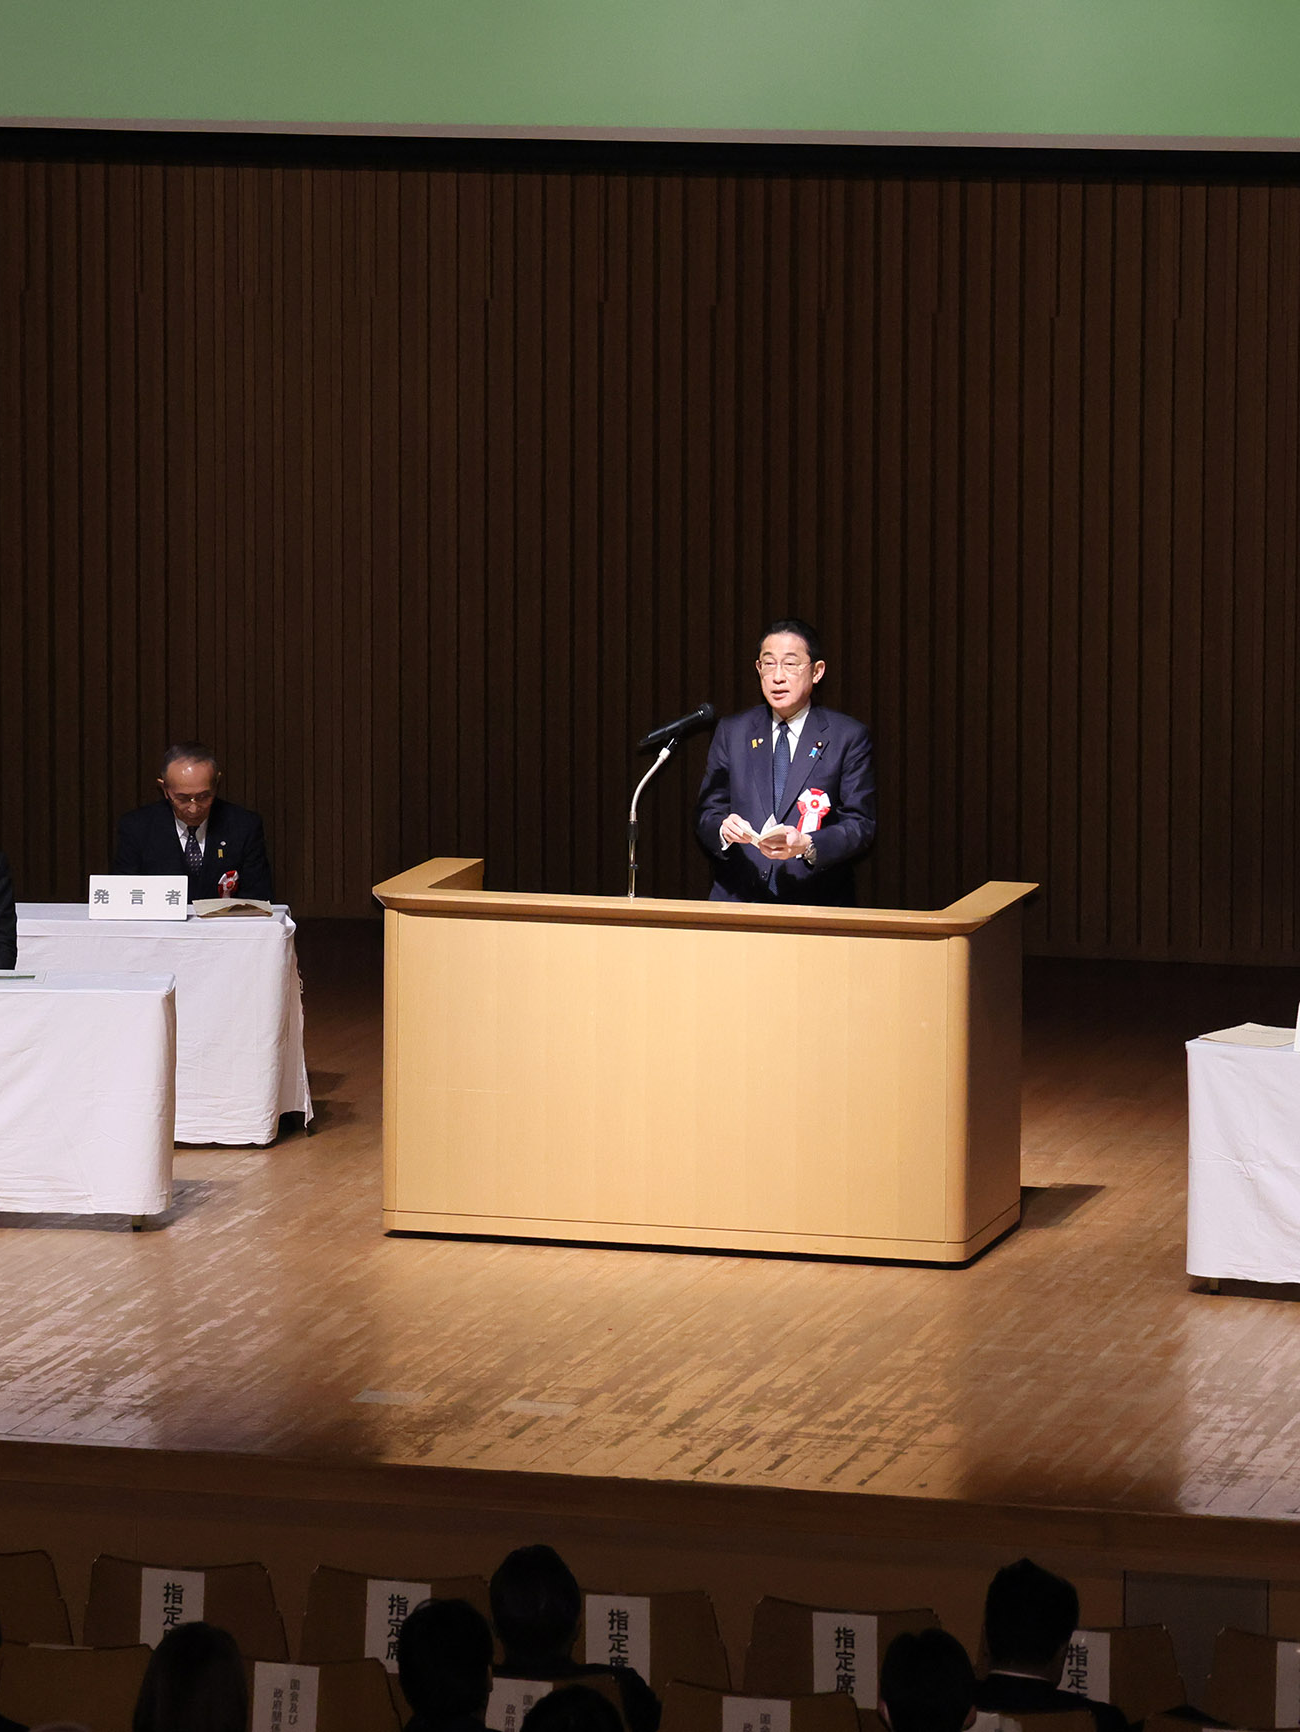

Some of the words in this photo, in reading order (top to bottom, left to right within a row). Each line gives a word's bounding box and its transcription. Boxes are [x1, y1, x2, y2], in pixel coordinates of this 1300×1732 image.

[94, 889, 182, 905] 発言者
[163, 1582, 184, 1637] 指定
[834, 1626, 856, 1695] 指定席
[1066, 1643, 1089, 1696] 指定
